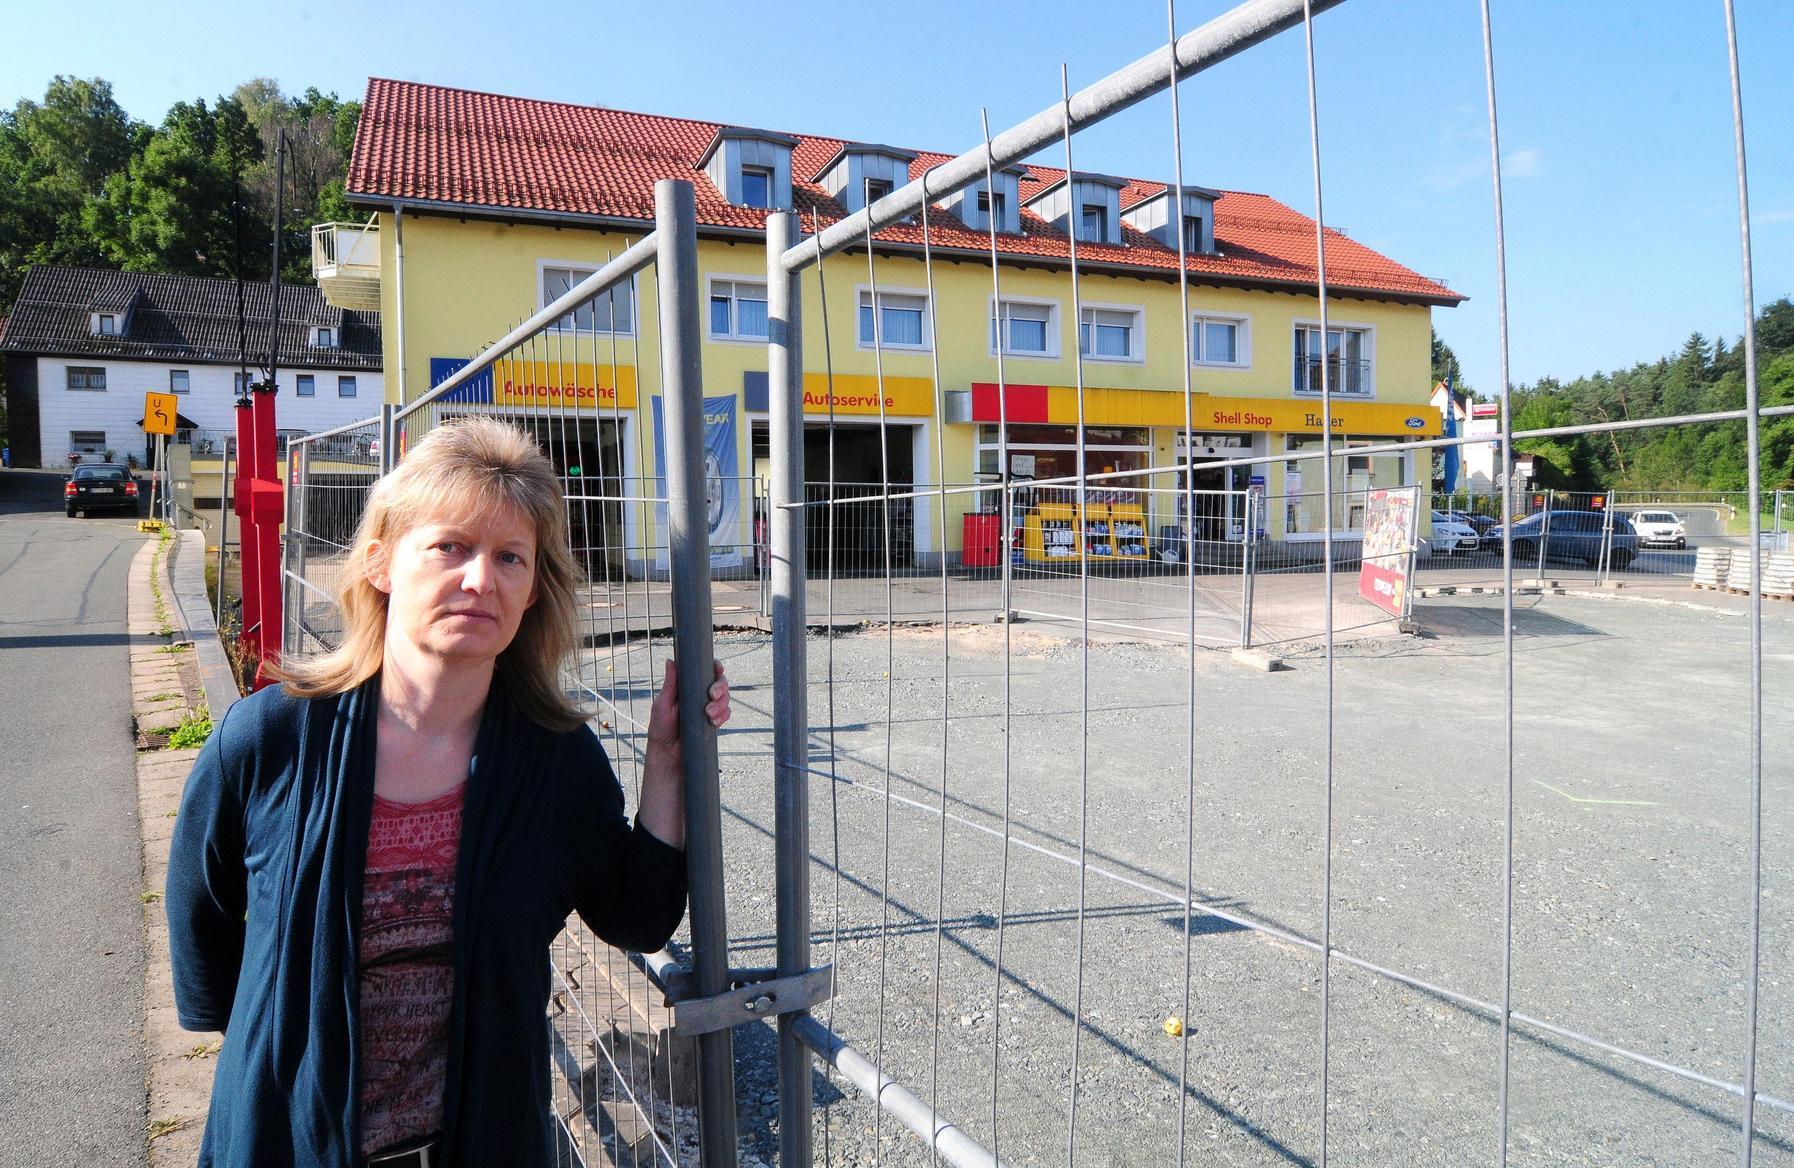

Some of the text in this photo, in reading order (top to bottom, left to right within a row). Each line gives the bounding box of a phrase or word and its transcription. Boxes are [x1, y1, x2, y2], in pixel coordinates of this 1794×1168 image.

[503, 381, 617, 399] Autowäsche
[153, 399, 161, 408] U
[1214, 411, 1273, 428] Shell Shop
[1304, 413, 1344, 427] Haer
